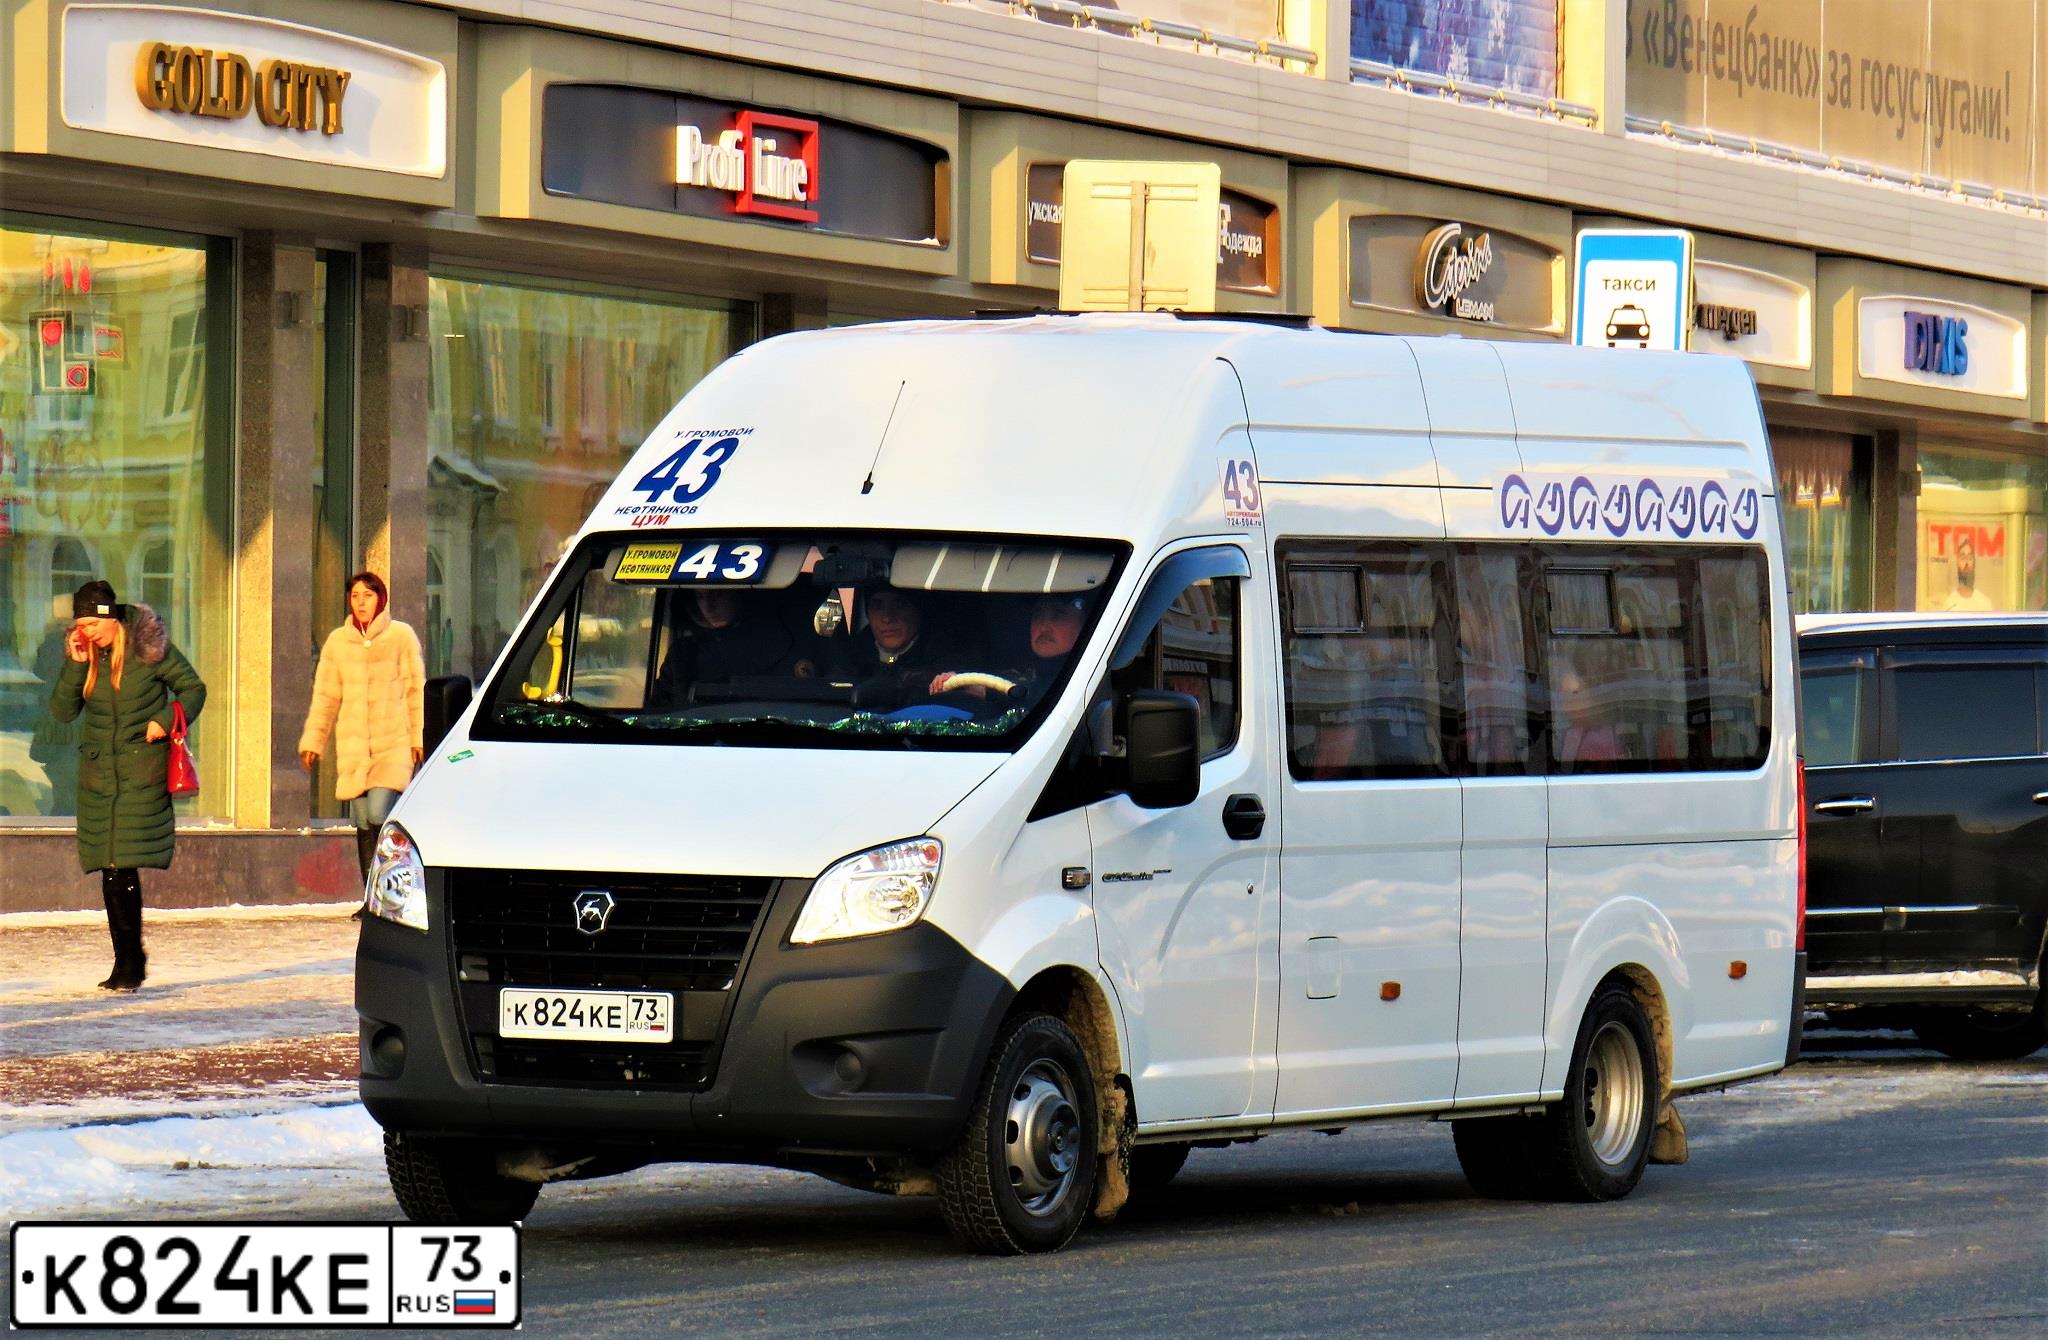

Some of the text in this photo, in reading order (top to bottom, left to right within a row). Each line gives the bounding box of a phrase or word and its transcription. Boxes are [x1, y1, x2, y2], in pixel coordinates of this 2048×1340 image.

[1643, 0, 1820, 99] «Венецбанк»
[1827, 49, 1852, 109] за
[1860, 55, 2011, 150] госуслугами!
[135, 41, 351, 136] GOLD CITY
[676, 125, 808, 202] Profi Line
[1225, 232, 1263, 258] одежда
[1602, 277, 1656, 292] такси
[632, 437, 740, 504] 43
[1224, 459, 1259, 511] 43
[615, 505, 699, 515] НЕФТЯНИКОВ
[631, 515, 671, 528] ЦУМ
[619, 564, 672, 574] НЕФТЯНИКОВ
[678, 544, 763, 580] 43
[631, 998, 658, 1021] 73
[629, 1021, 650, 1031] RUS
